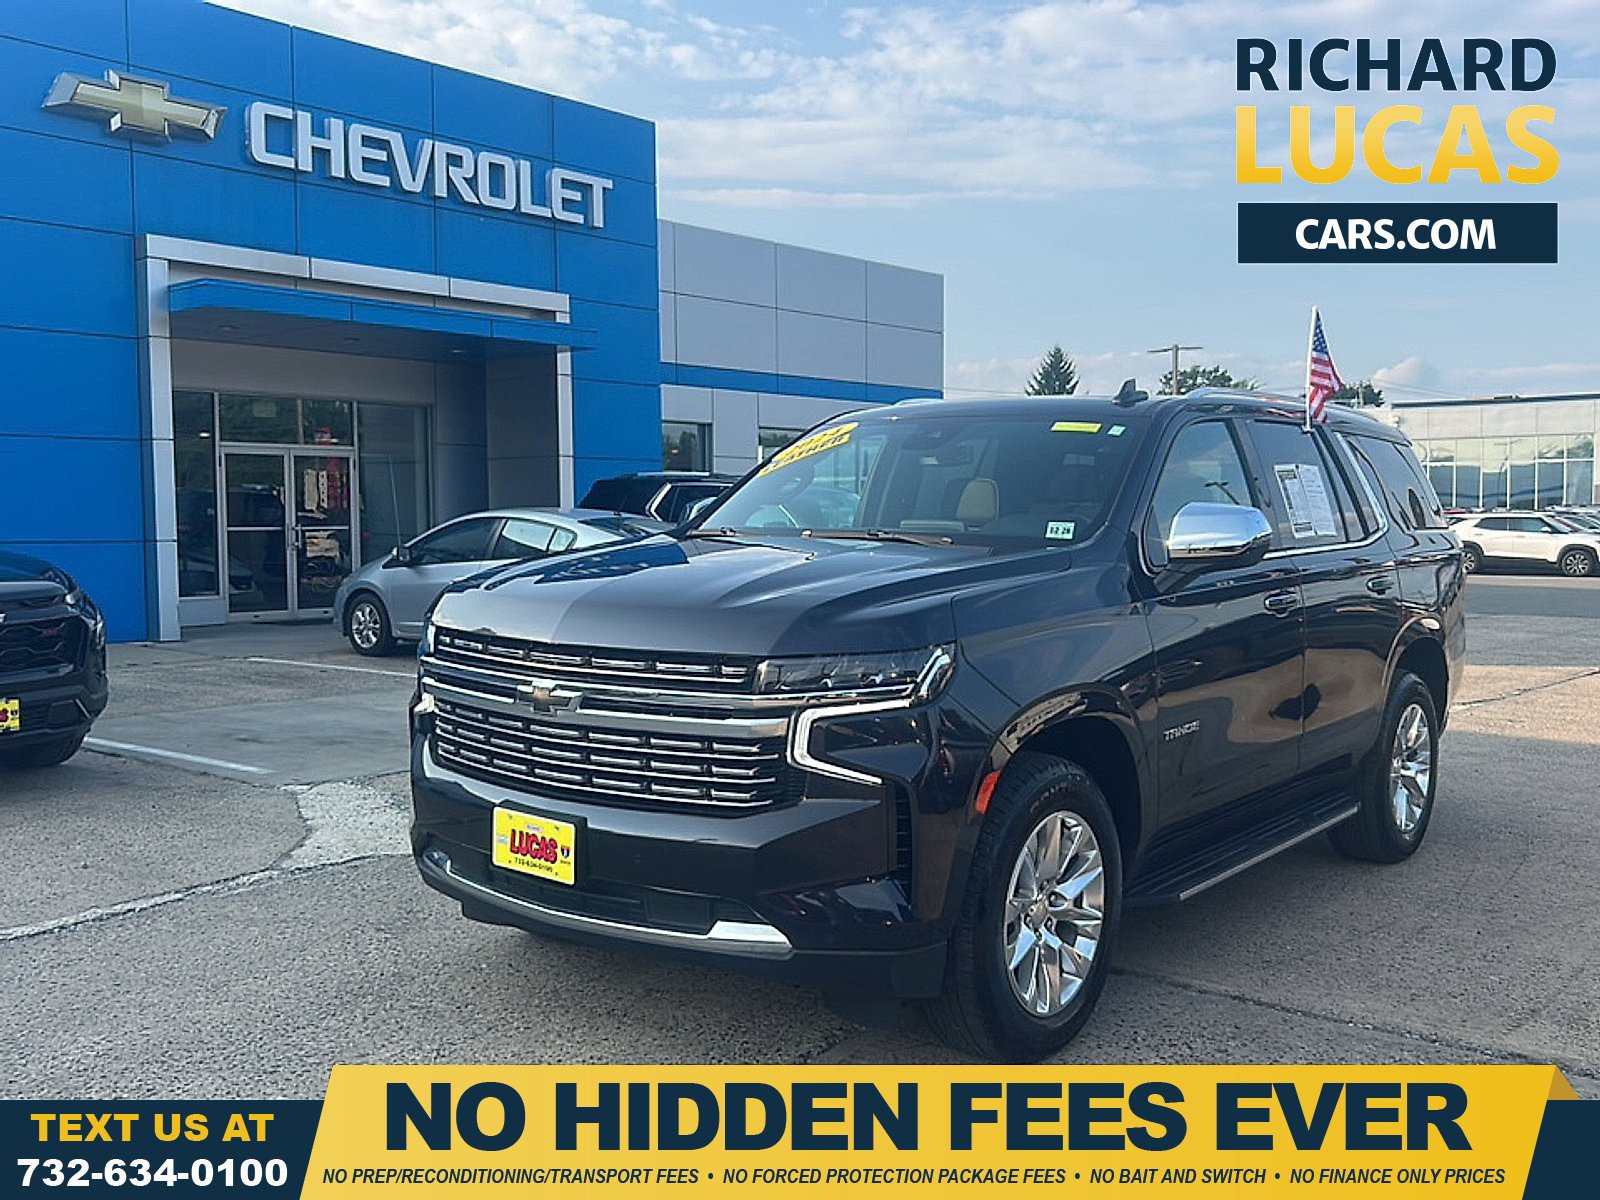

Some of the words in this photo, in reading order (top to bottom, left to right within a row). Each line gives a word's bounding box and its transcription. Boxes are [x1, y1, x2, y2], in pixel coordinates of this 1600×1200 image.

[246, 101, 613, 228] CHEVROLET
[1163, 720, 1200, 741] TAHOE
[509, 828, 558, 865] LUCAS
